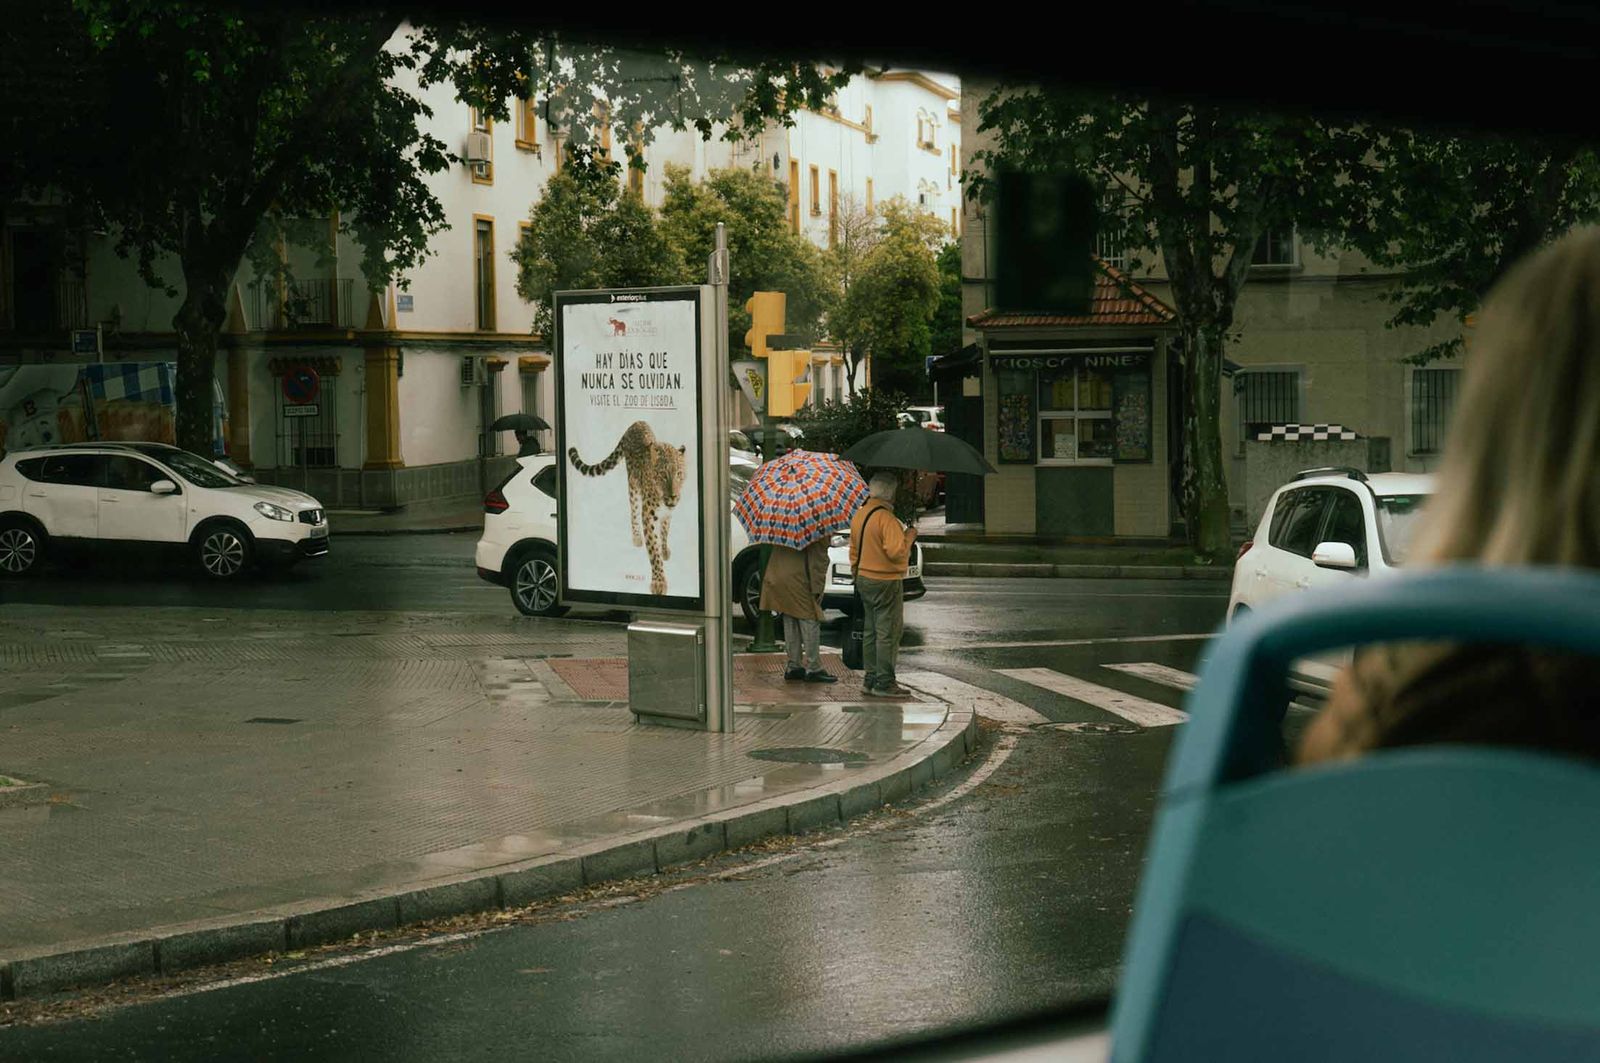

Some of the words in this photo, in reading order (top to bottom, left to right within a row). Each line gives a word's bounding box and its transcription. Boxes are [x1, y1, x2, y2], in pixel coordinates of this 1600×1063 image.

[595, 352, 613, 369] HAY
[619, 349, 644, 369] DÍAS
[649, 352, 668, 369] QUE
[581, 372, 615, 389] NUNCA
[621, 372, 635, 389] SE
[639, 372, 684, 389] OLVIDAN.
[590, 394, 610, 407] VISITE
[613, 394, 621, 407] EL
[624, 394, 639, 407] ZOO
[641, 394, 649, 407] DE
